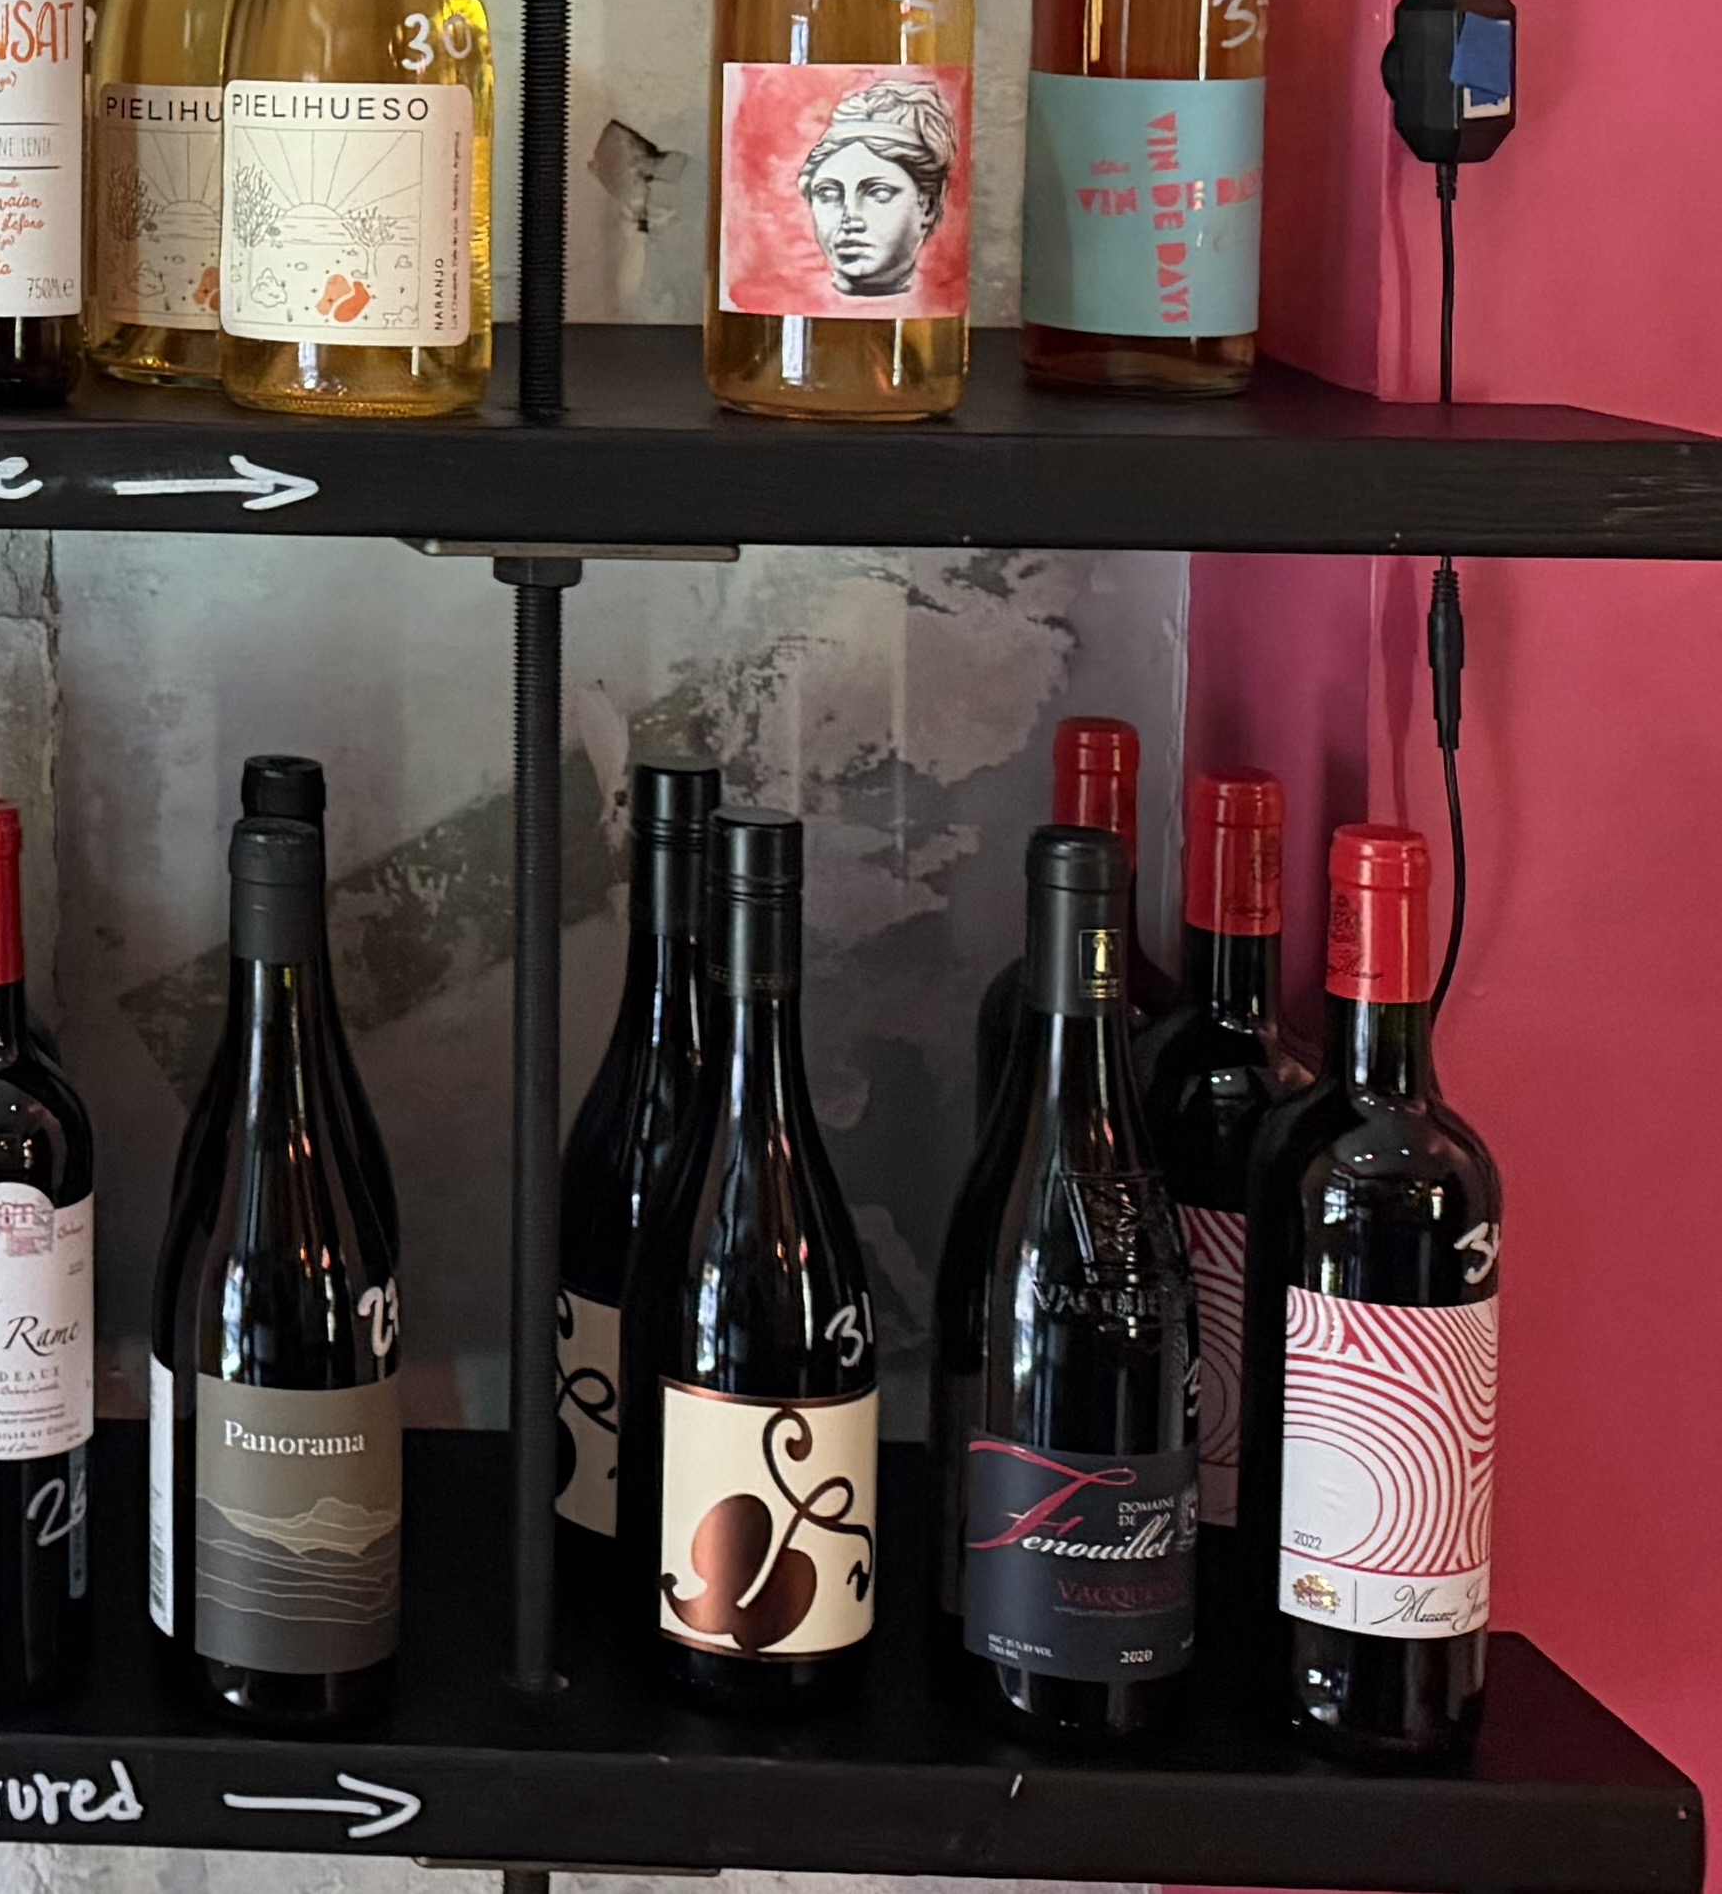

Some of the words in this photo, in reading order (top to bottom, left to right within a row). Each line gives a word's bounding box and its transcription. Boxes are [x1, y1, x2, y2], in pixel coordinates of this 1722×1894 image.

[401, 12, 473, 71] 30
[231, 92, 430, 122] PIELIHUESO
[1146, 110, 1181, 172] VIN
[1, 212, 46, 235] stefano
[1149, 182, 1186, 230] DE
[433, 256, 445, 331] NARANJO
[1155, 241, 1192, 324] DAYS
[2, 1314, 83, 1357] Rame
[222, 1419, 367, 1458] Panorama
[1292, 1530, 1323, 1551] 2022
